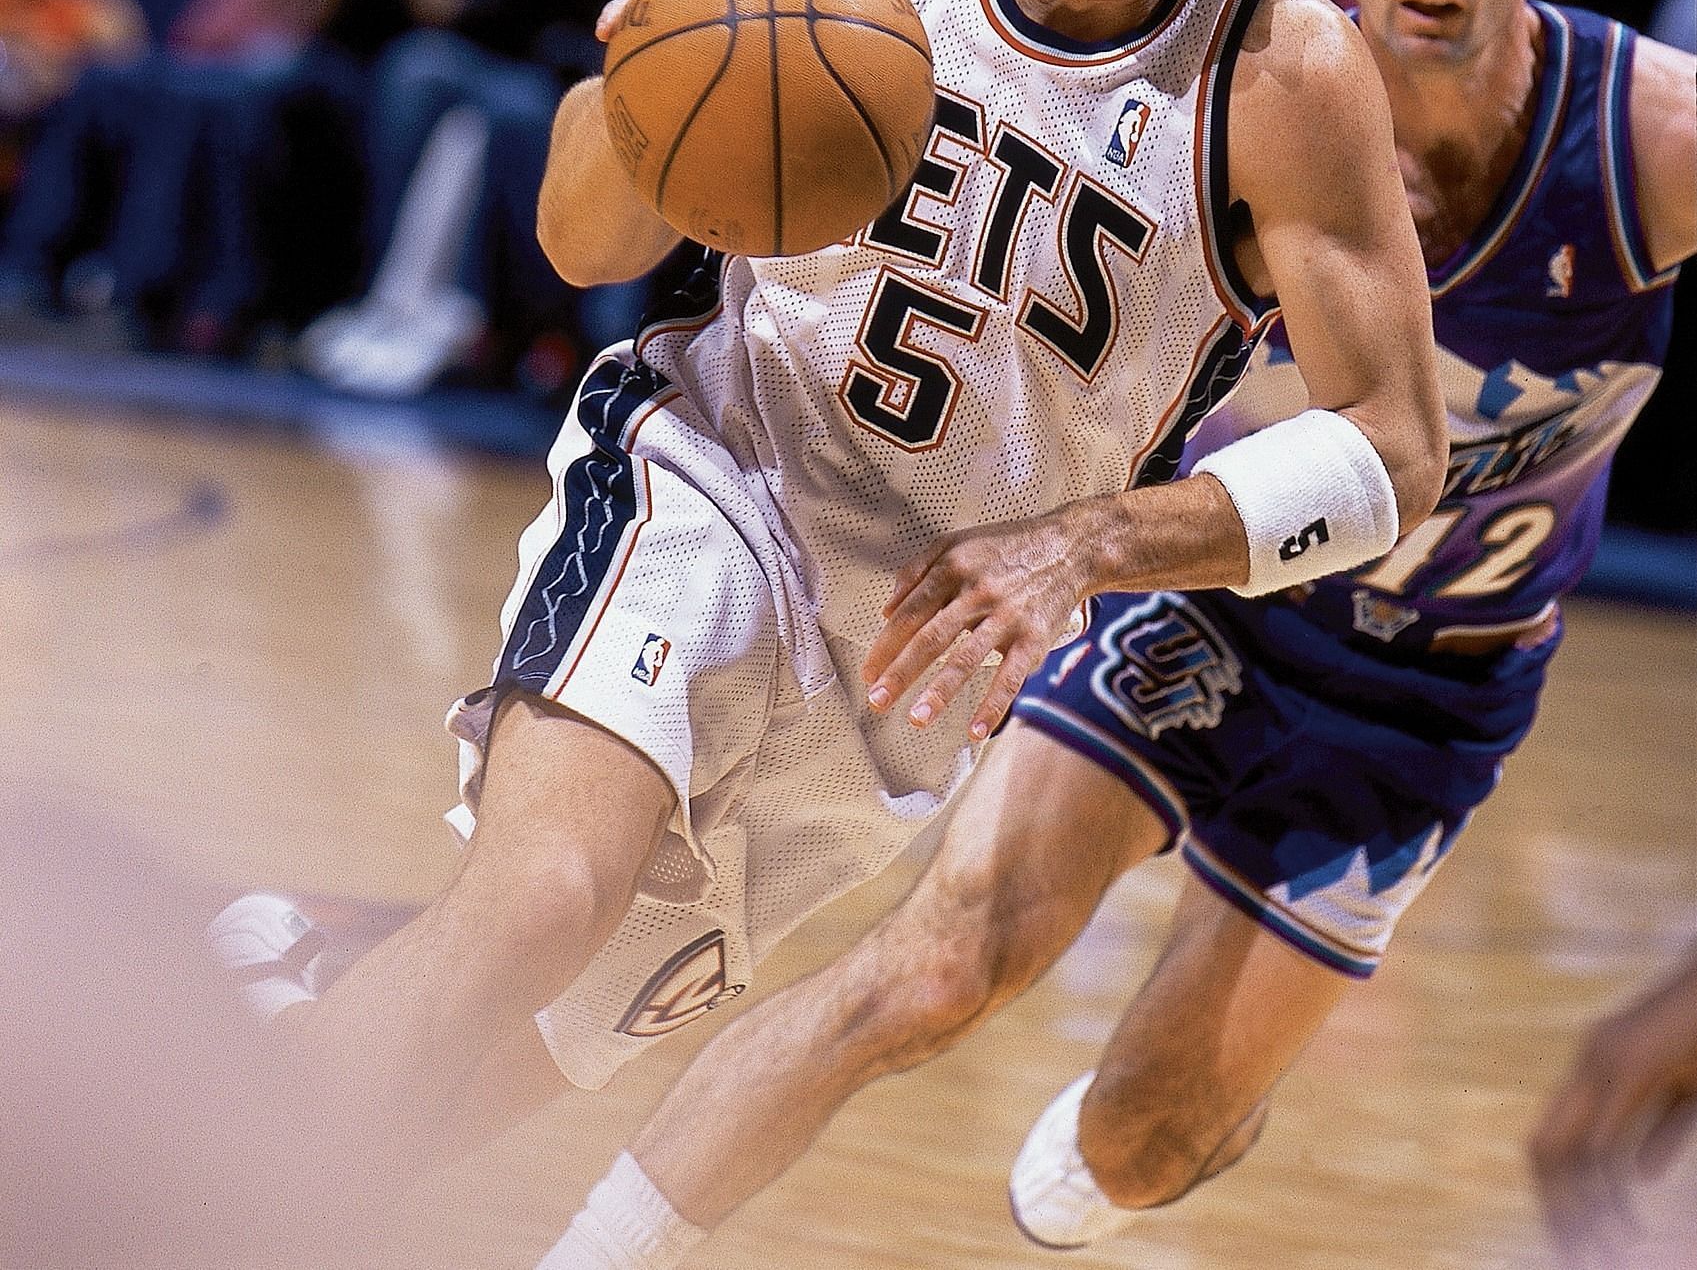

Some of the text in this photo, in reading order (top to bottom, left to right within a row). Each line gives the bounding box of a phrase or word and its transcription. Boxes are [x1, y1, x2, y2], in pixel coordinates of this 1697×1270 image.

[846, 84, 1158, 386] ETS
[838, 263, 990, 454] 5
[1279, 517, 1330, 561] 5
[1354, 501, 1556, 598] 12
